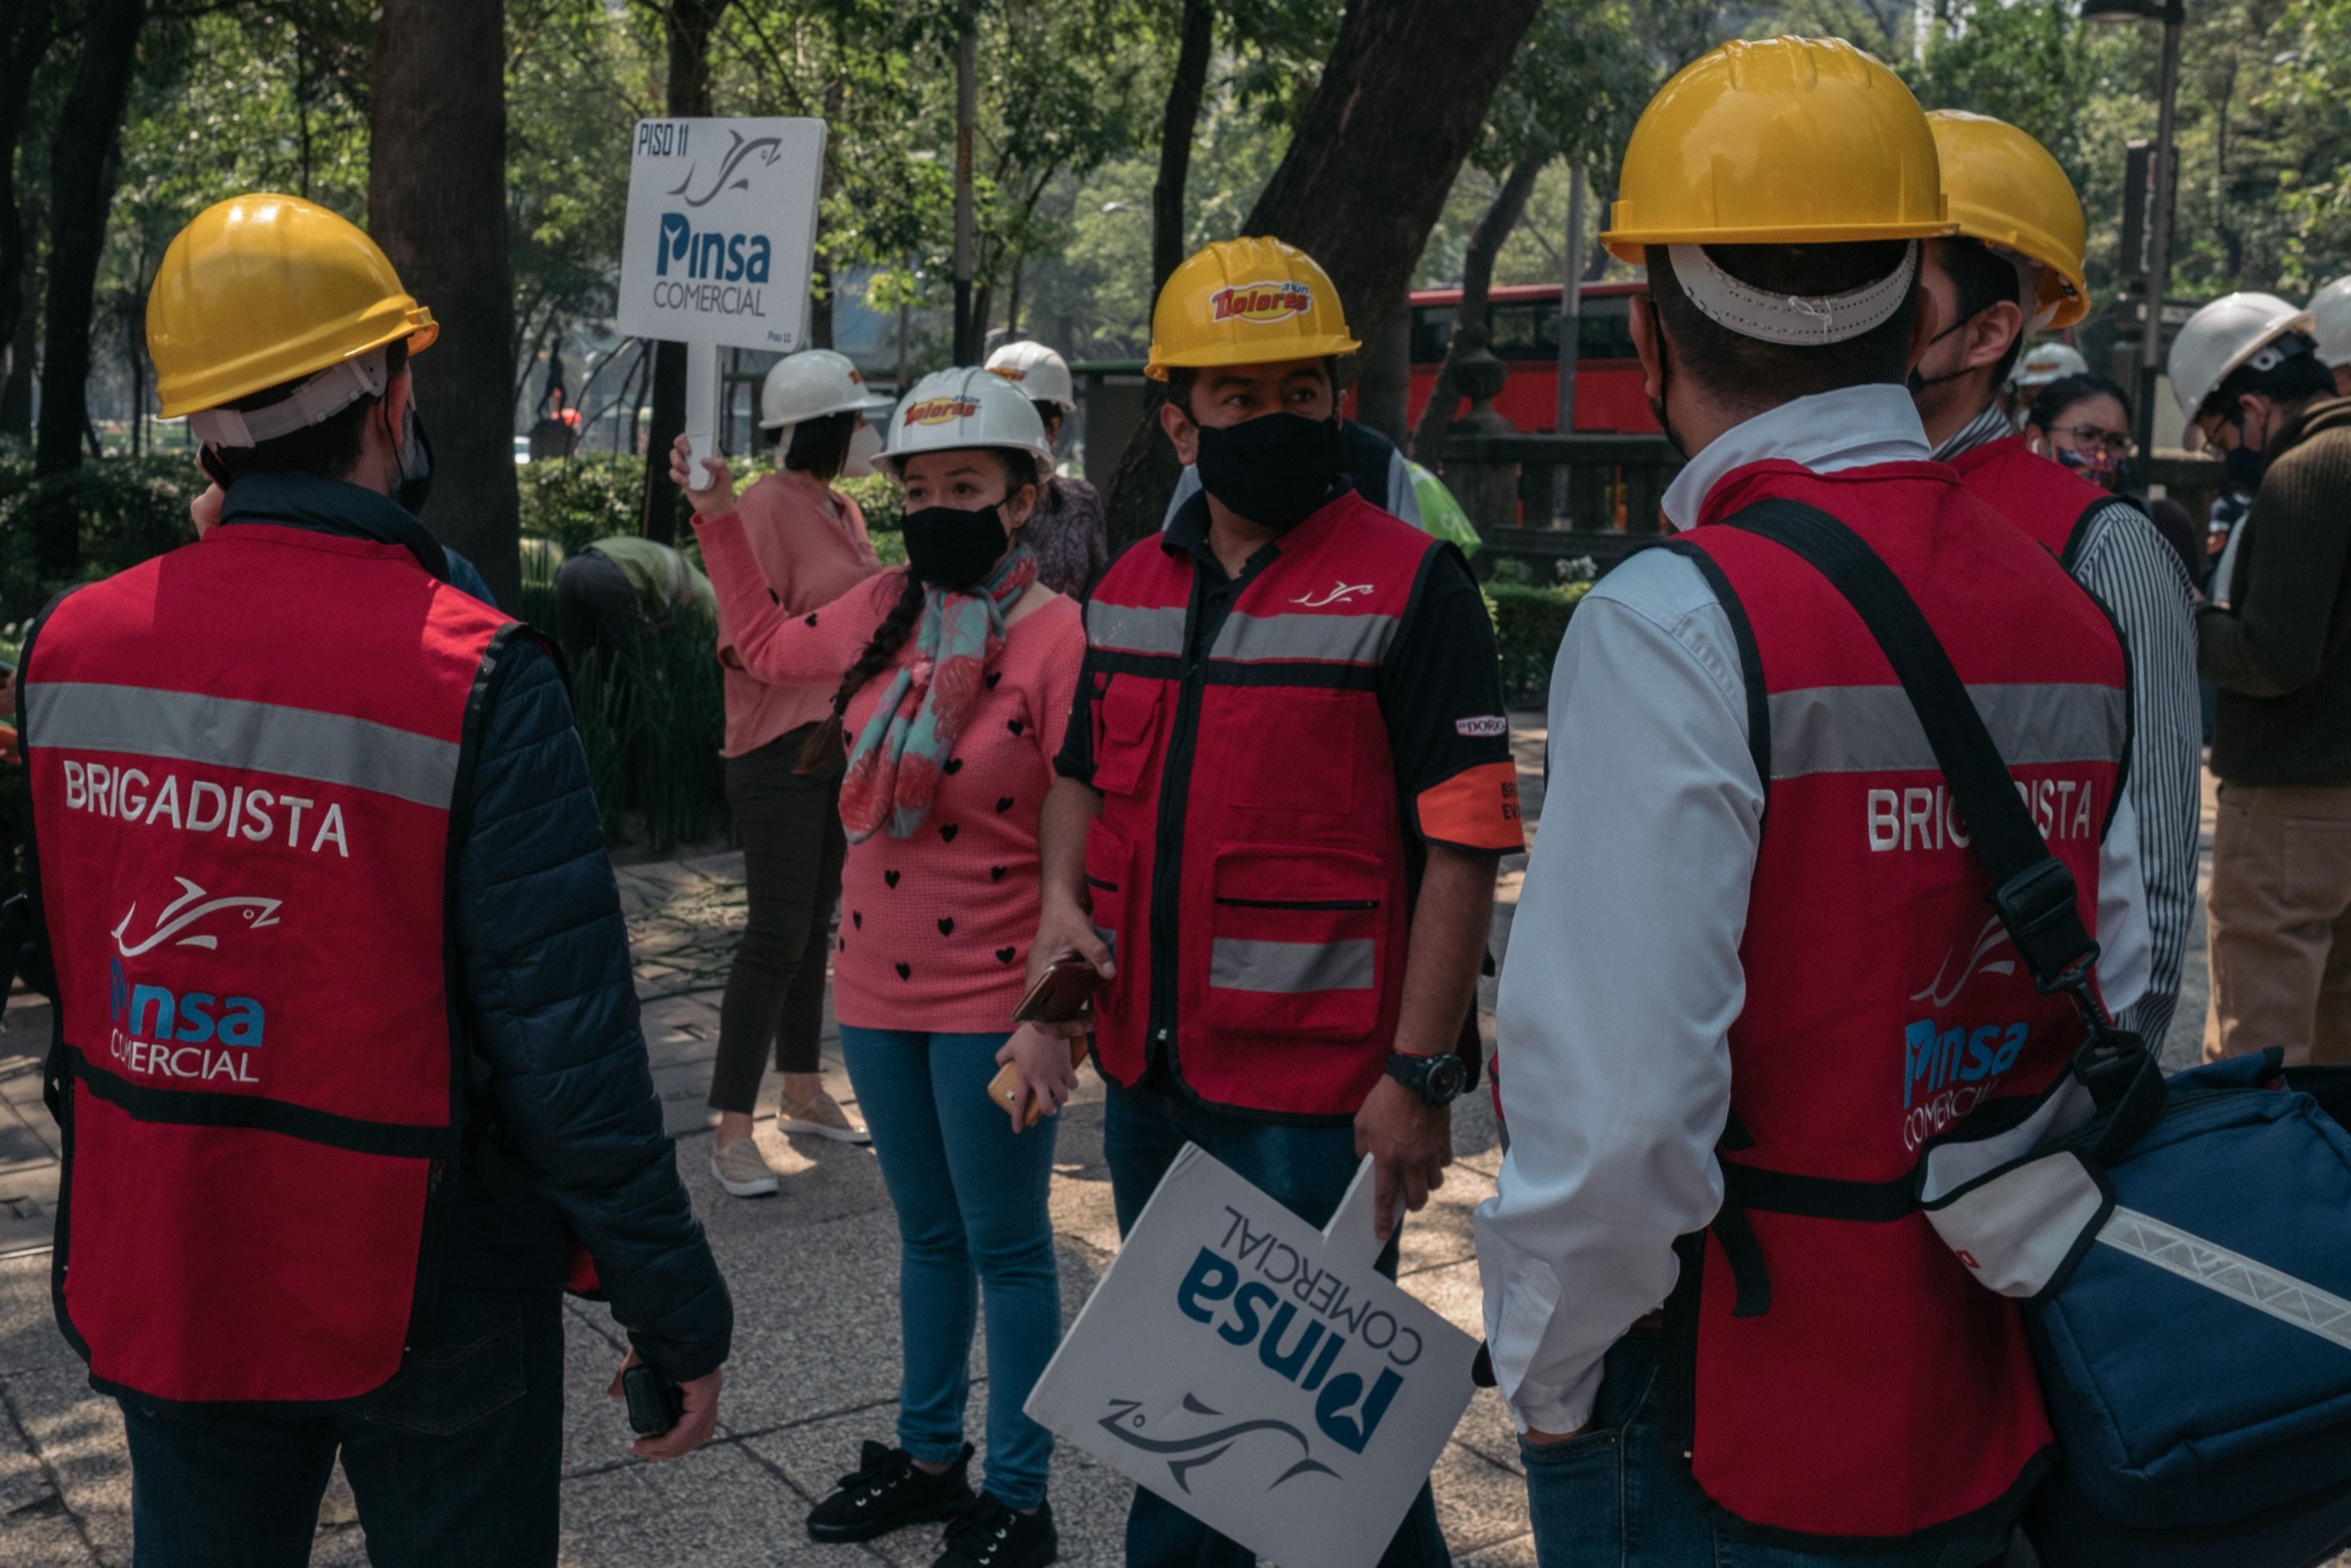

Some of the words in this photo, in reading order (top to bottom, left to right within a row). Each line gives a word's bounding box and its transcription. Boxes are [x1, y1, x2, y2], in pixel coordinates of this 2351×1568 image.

[638, 123, 673, 156] PISO
[677, 123, 689, 157] 11
[656, 212, 772, 283] Pinsa
[653, 281, 766, 317] COMERCIAL
[1211, 289, 1308, 320] Dolores
[64, 760, 349, 858] BRIGADISTA
[1903, 1018, 2030, 1110] Pinsa
[1220, 1205, 1423, 1366] COMERCIAL
[1177, 1246, 1404, 1455] Pinsa
